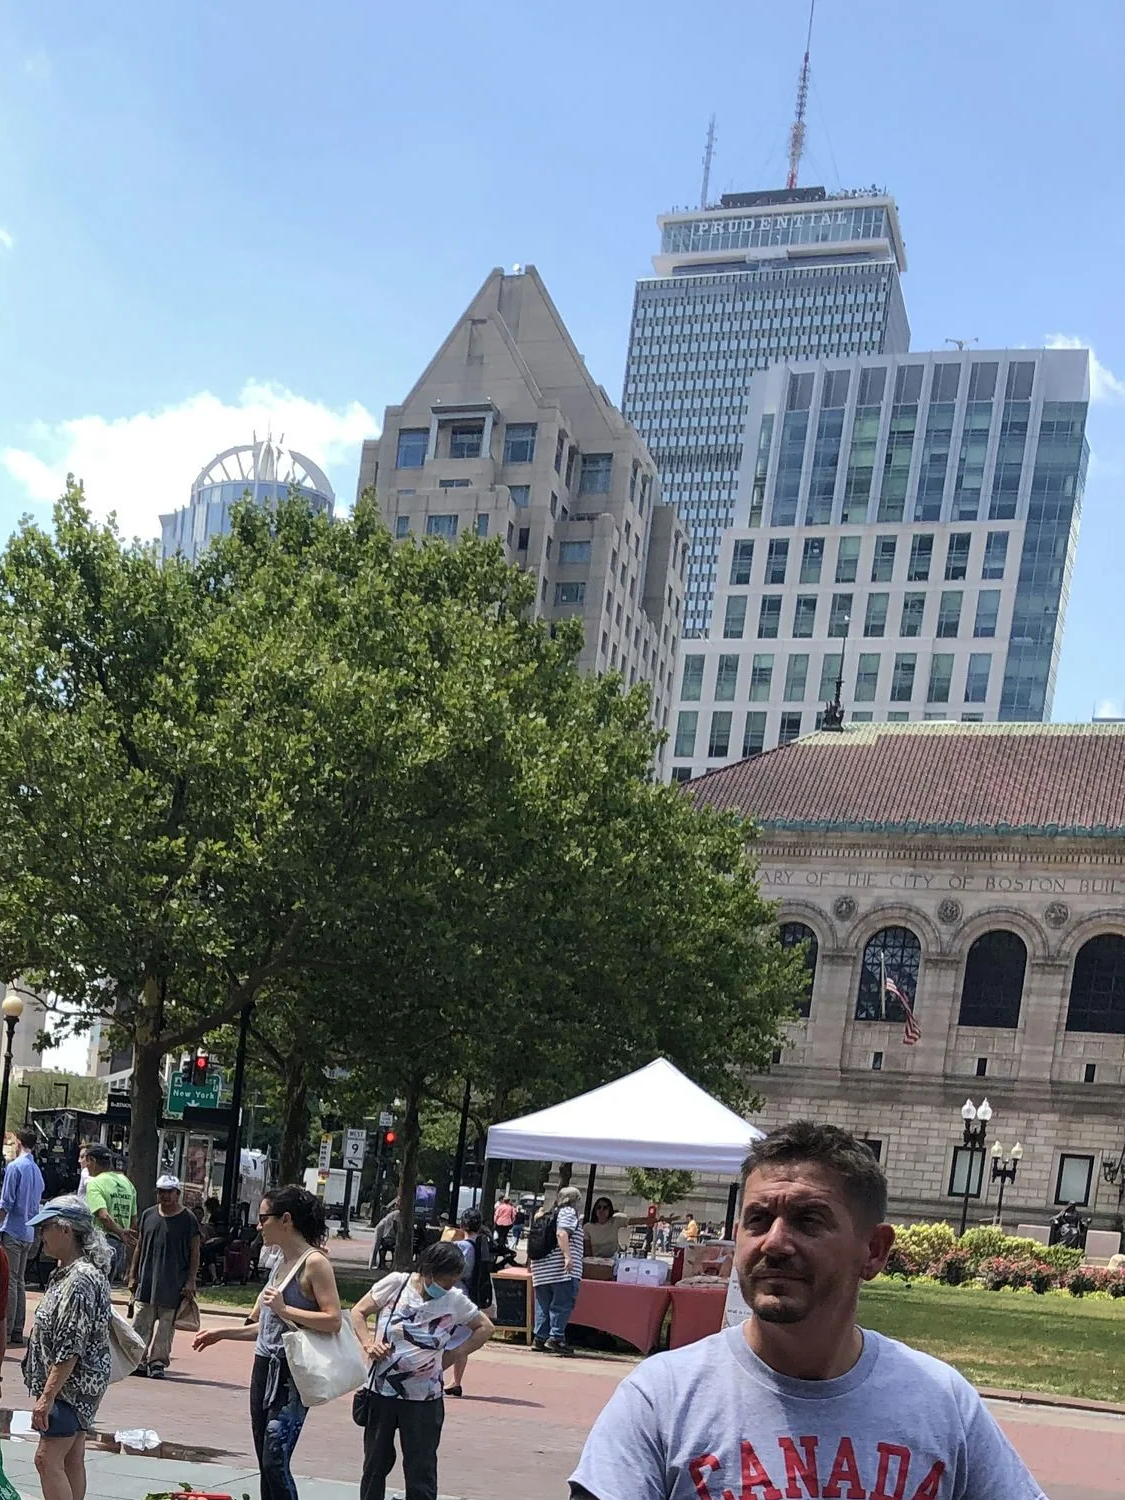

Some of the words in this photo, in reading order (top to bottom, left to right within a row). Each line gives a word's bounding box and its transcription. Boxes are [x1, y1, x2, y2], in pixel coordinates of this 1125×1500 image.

[697, 211, 848, 236] PRUDENTIAL
[759, 870, 794, 886] ARY
[805, 871, 829, 886] OF
[846, 872, 877, 887] THE
[889, 873, 934, 889] CITY
[948, 875, 974, 890] OF
[985, 876, 1068, 893] BOSTON
[1079, 878, 1125, 894] BUIL
[172, 1089, 192, 1098] New
[195, 1090, 215, 1100] York
[351, 1143, 359, 1155] 9
